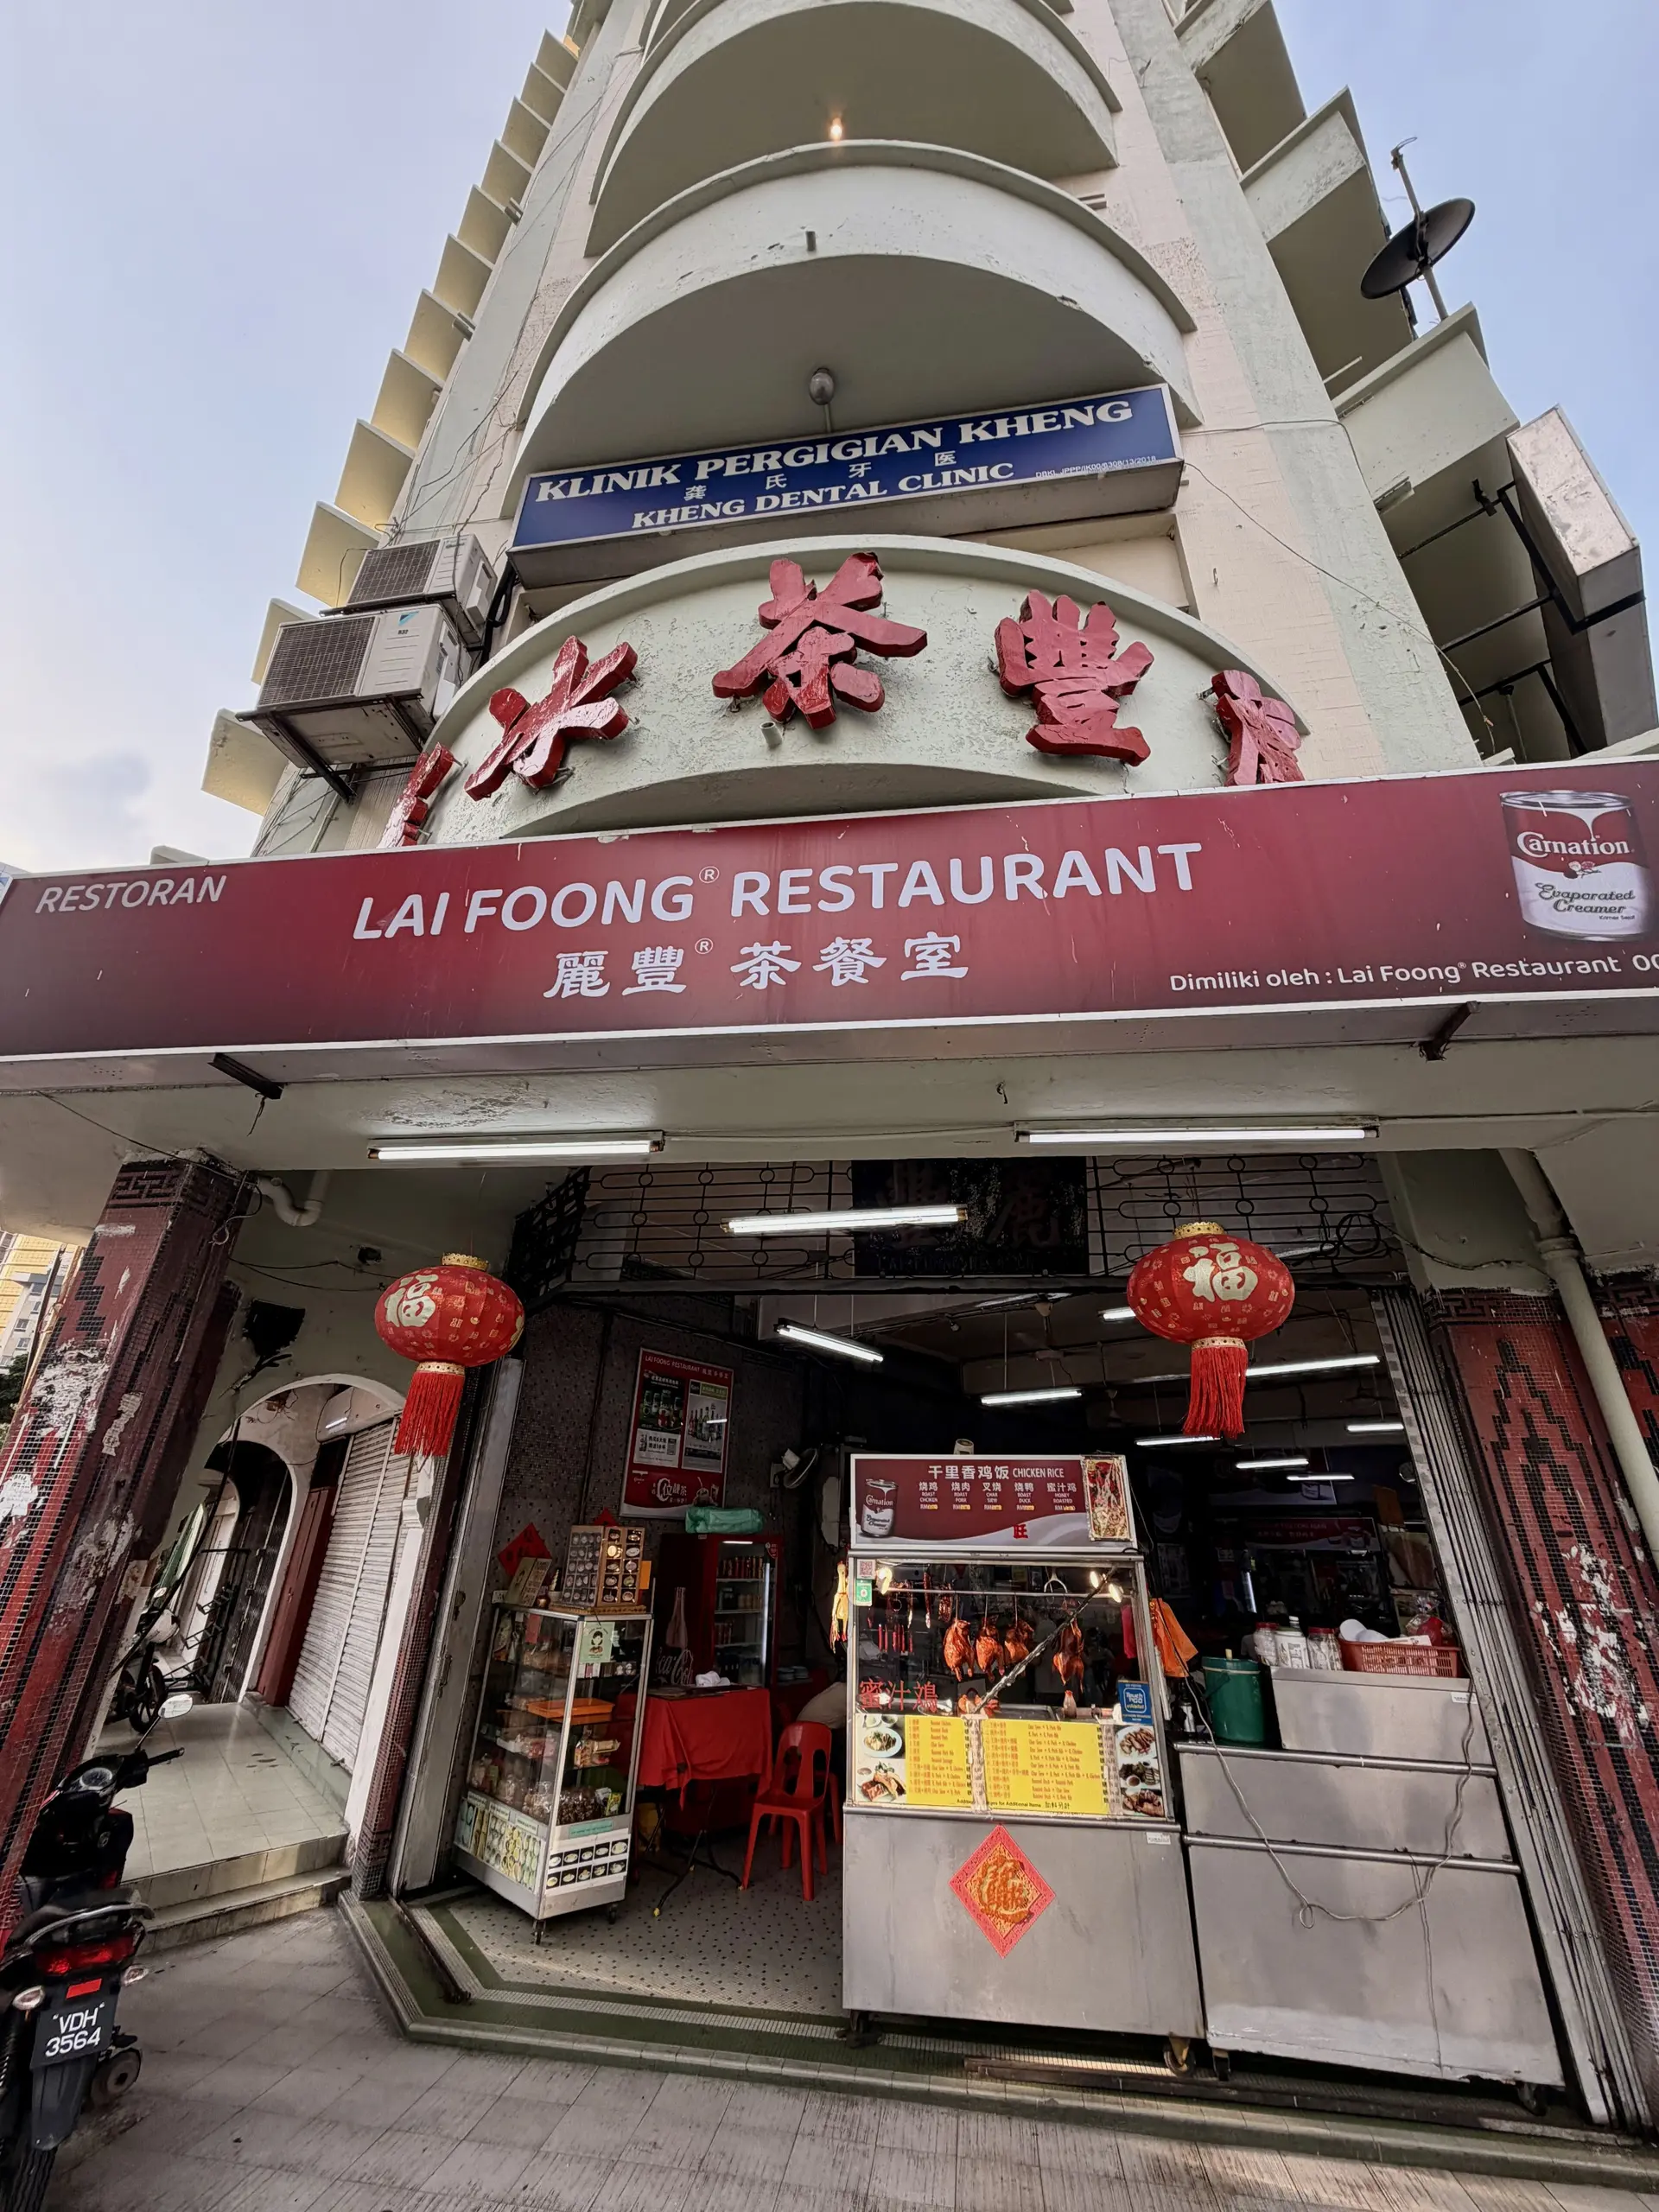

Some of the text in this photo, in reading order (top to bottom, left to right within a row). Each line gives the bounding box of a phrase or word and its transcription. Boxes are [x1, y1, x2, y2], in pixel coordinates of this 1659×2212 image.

[536, 400, 1132, 502] KLINIK PERGIGIAN KHENG
[632, 462, 1014, 529] KHENG DENTAL CLINIC
[1517, 831, 1630, 858] Carnation
[35, 874, 227, 914] RESTORAN
[353, 892, 450, 939] LAI
[731, 842, 1203, 917] RESTAURANT
[1535, 882, 1636, 902] Evaporated
[1553, 899, 1627, 913] Creamer
[1169, 969, 1260, 991] Dimiliki
[1266, 968, 1320, 987] oleh
[1338, 965, 1374, 983] Lai
[1471, 956, 1621, 978] Restaurant
[1183, 1242, 1258, 1302] 福
[671, 1361, 700, 1372] RESTAURANT
[951, 1482, 970, 1491] 烧肉
[982, 1482, 1001, 1491] 叉烧
[1013, 1468, 1046, 1478] CHICKEN
[1047, 1468, 1065, 1478] RICE
[1014, 1482, 1033, 1492] 烧鸭
[59, 2006, 99, 2034] VDH
[45, 2026, 101, 2057] 3564
